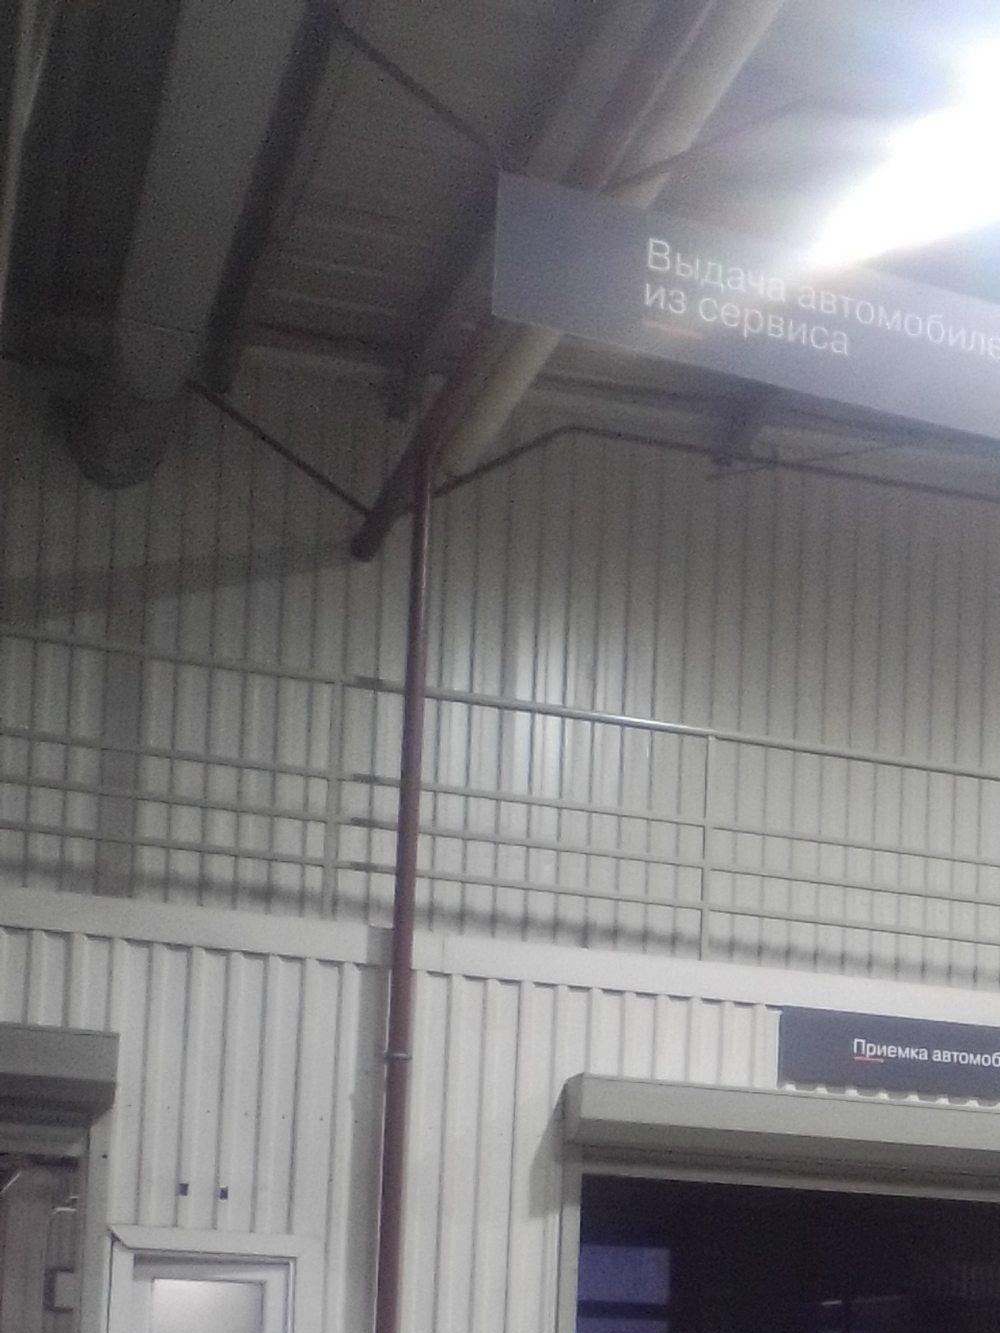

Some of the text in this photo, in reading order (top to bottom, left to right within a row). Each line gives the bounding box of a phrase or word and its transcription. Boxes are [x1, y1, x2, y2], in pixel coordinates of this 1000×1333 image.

[646, 237, 788, 302] Выдача
[643, 282, 849, 355] из сервиса
[853, 1038, 929, 1061] Приемка
